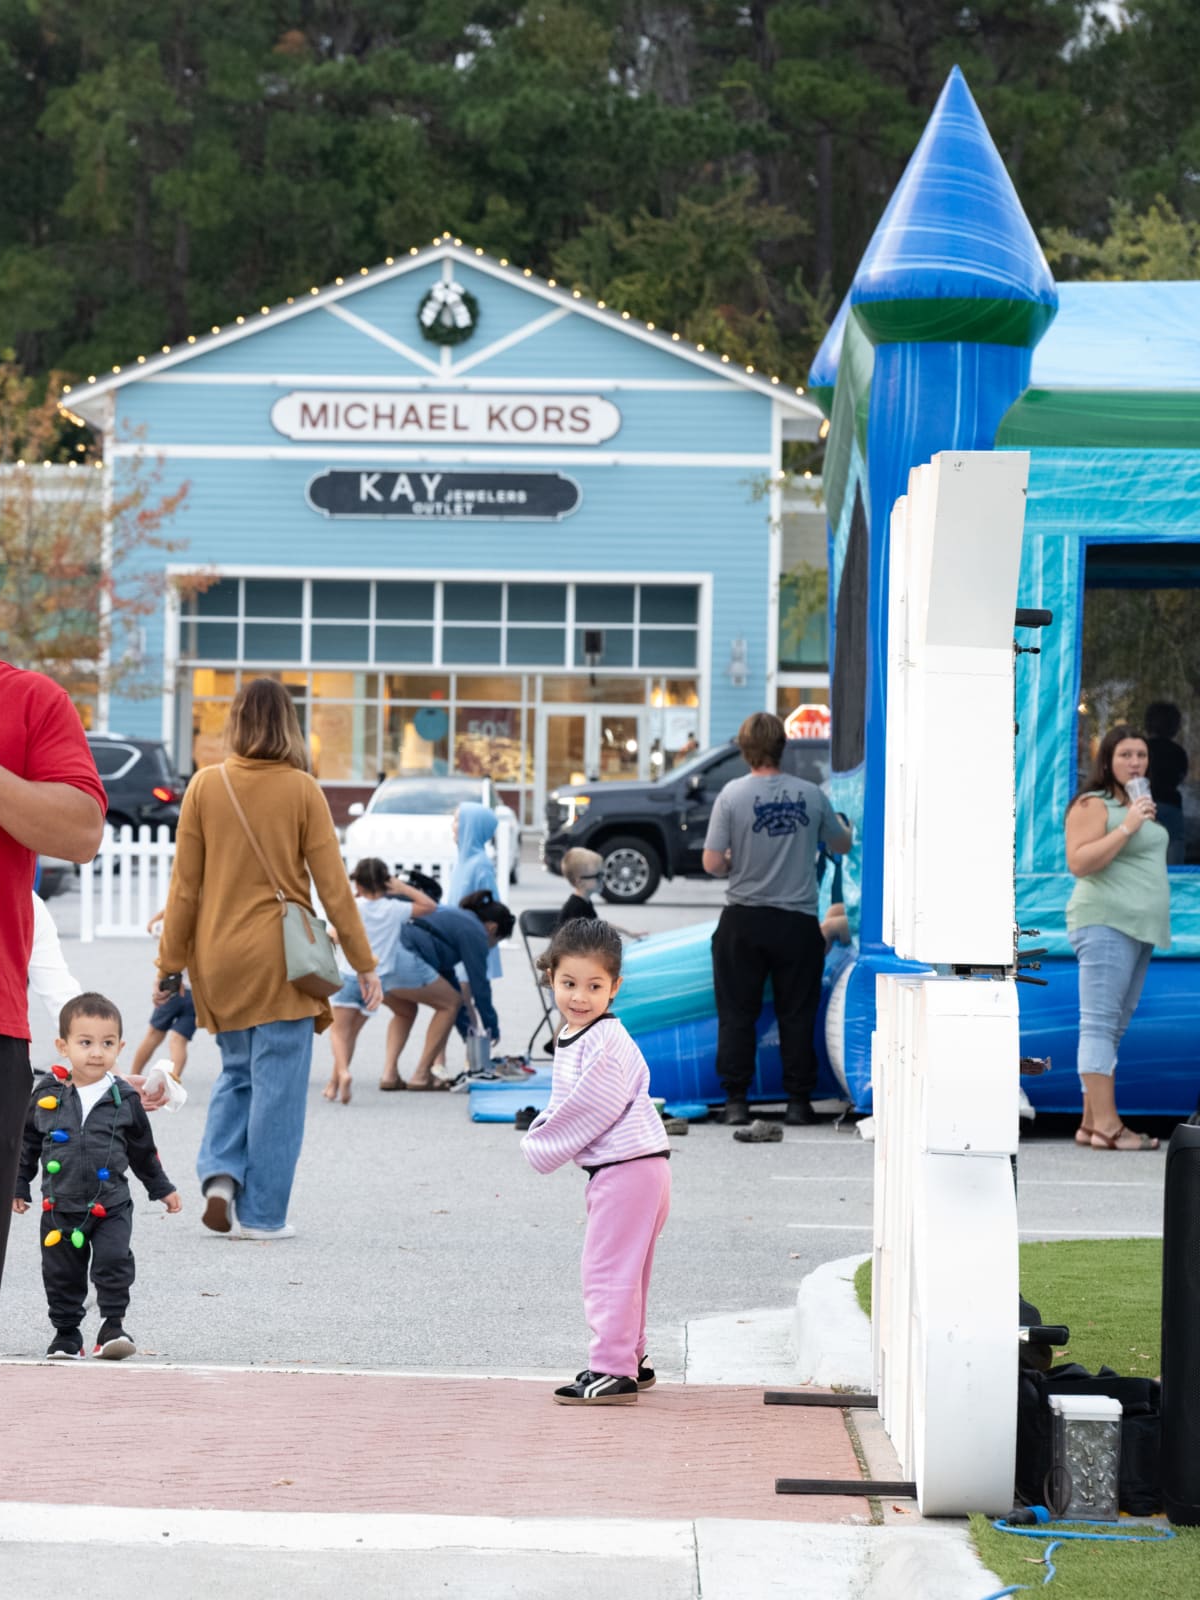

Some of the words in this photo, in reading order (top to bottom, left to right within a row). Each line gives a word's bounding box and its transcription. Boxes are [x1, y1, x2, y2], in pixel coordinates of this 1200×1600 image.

[299, 402, 469, 431] MICHAEL
[487, 405, 591, 433] KORS
[359, 473, 443, 503] KAY
[444, 489, 528, 504] JEWELERS
[411, 501, 475, 515] OUTLET
